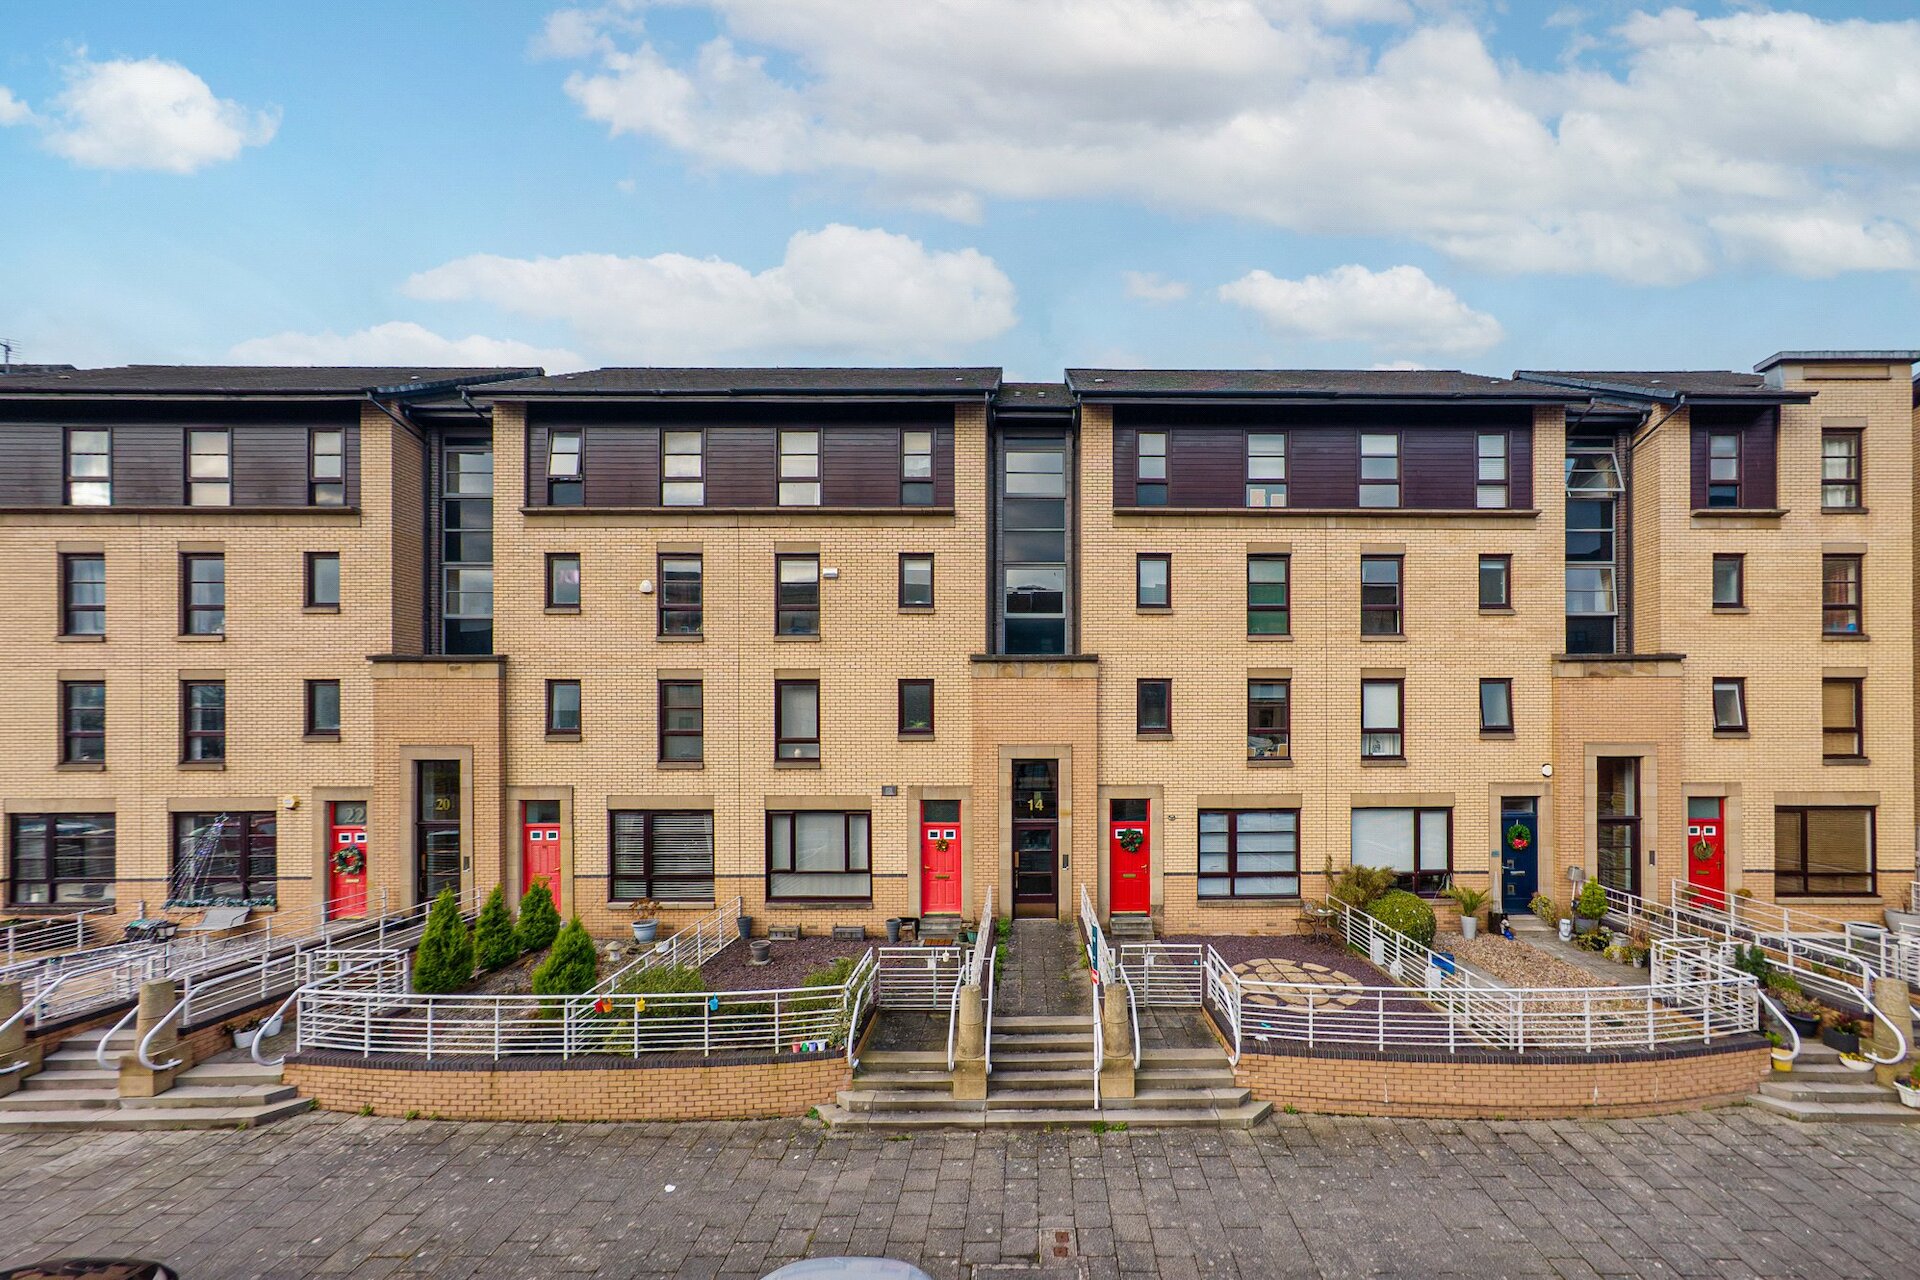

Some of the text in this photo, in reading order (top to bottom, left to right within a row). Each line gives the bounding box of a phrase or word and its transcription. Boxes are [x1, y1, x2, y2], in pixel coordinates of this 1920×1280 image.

[435, 798, 450, 810] 20
[1027, 799, 1044, 811] 14
[344, 807, 365, 822] 22
